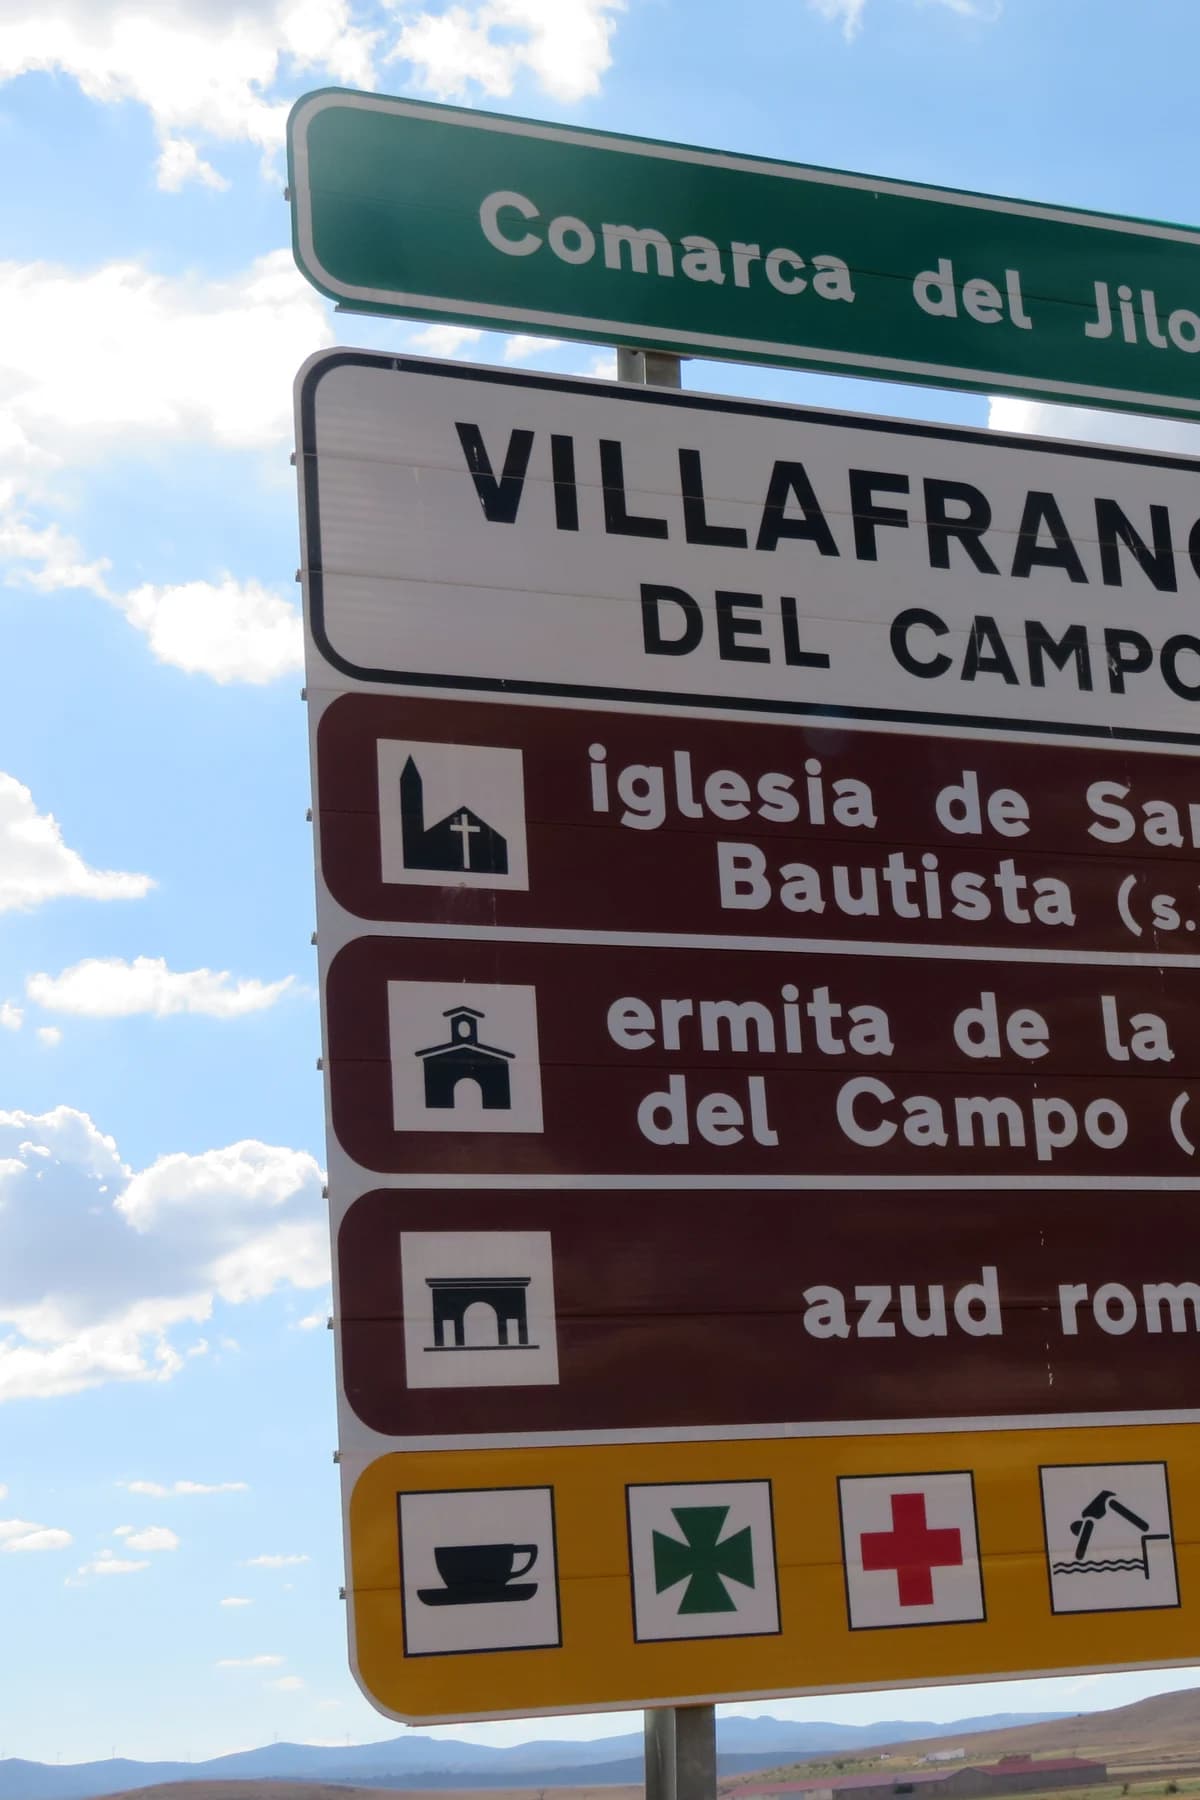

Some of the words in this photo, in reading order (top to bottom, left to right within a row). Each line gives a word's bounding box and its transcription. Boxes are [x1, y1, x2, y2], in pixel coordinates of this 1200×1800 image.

[478, 189, 855, 302] Comarca
[913, 258, 1032, 329] del
[640, 584, 830, 668] DEL
[589, 743, 877, 830] iglesia
[936, 771, 1030, 837] de
[717, 842, 1076, 926] Bautista
[607, 984, 894, 1056] ermita
[954, 992, 1049, 1058] de
[1101, 996, 1175, 1062] la
[638, 1075, 778, 1145] del
[837, 1077, 1128, 1160] Campo
[803, 1266, 1002, 1338] azud
